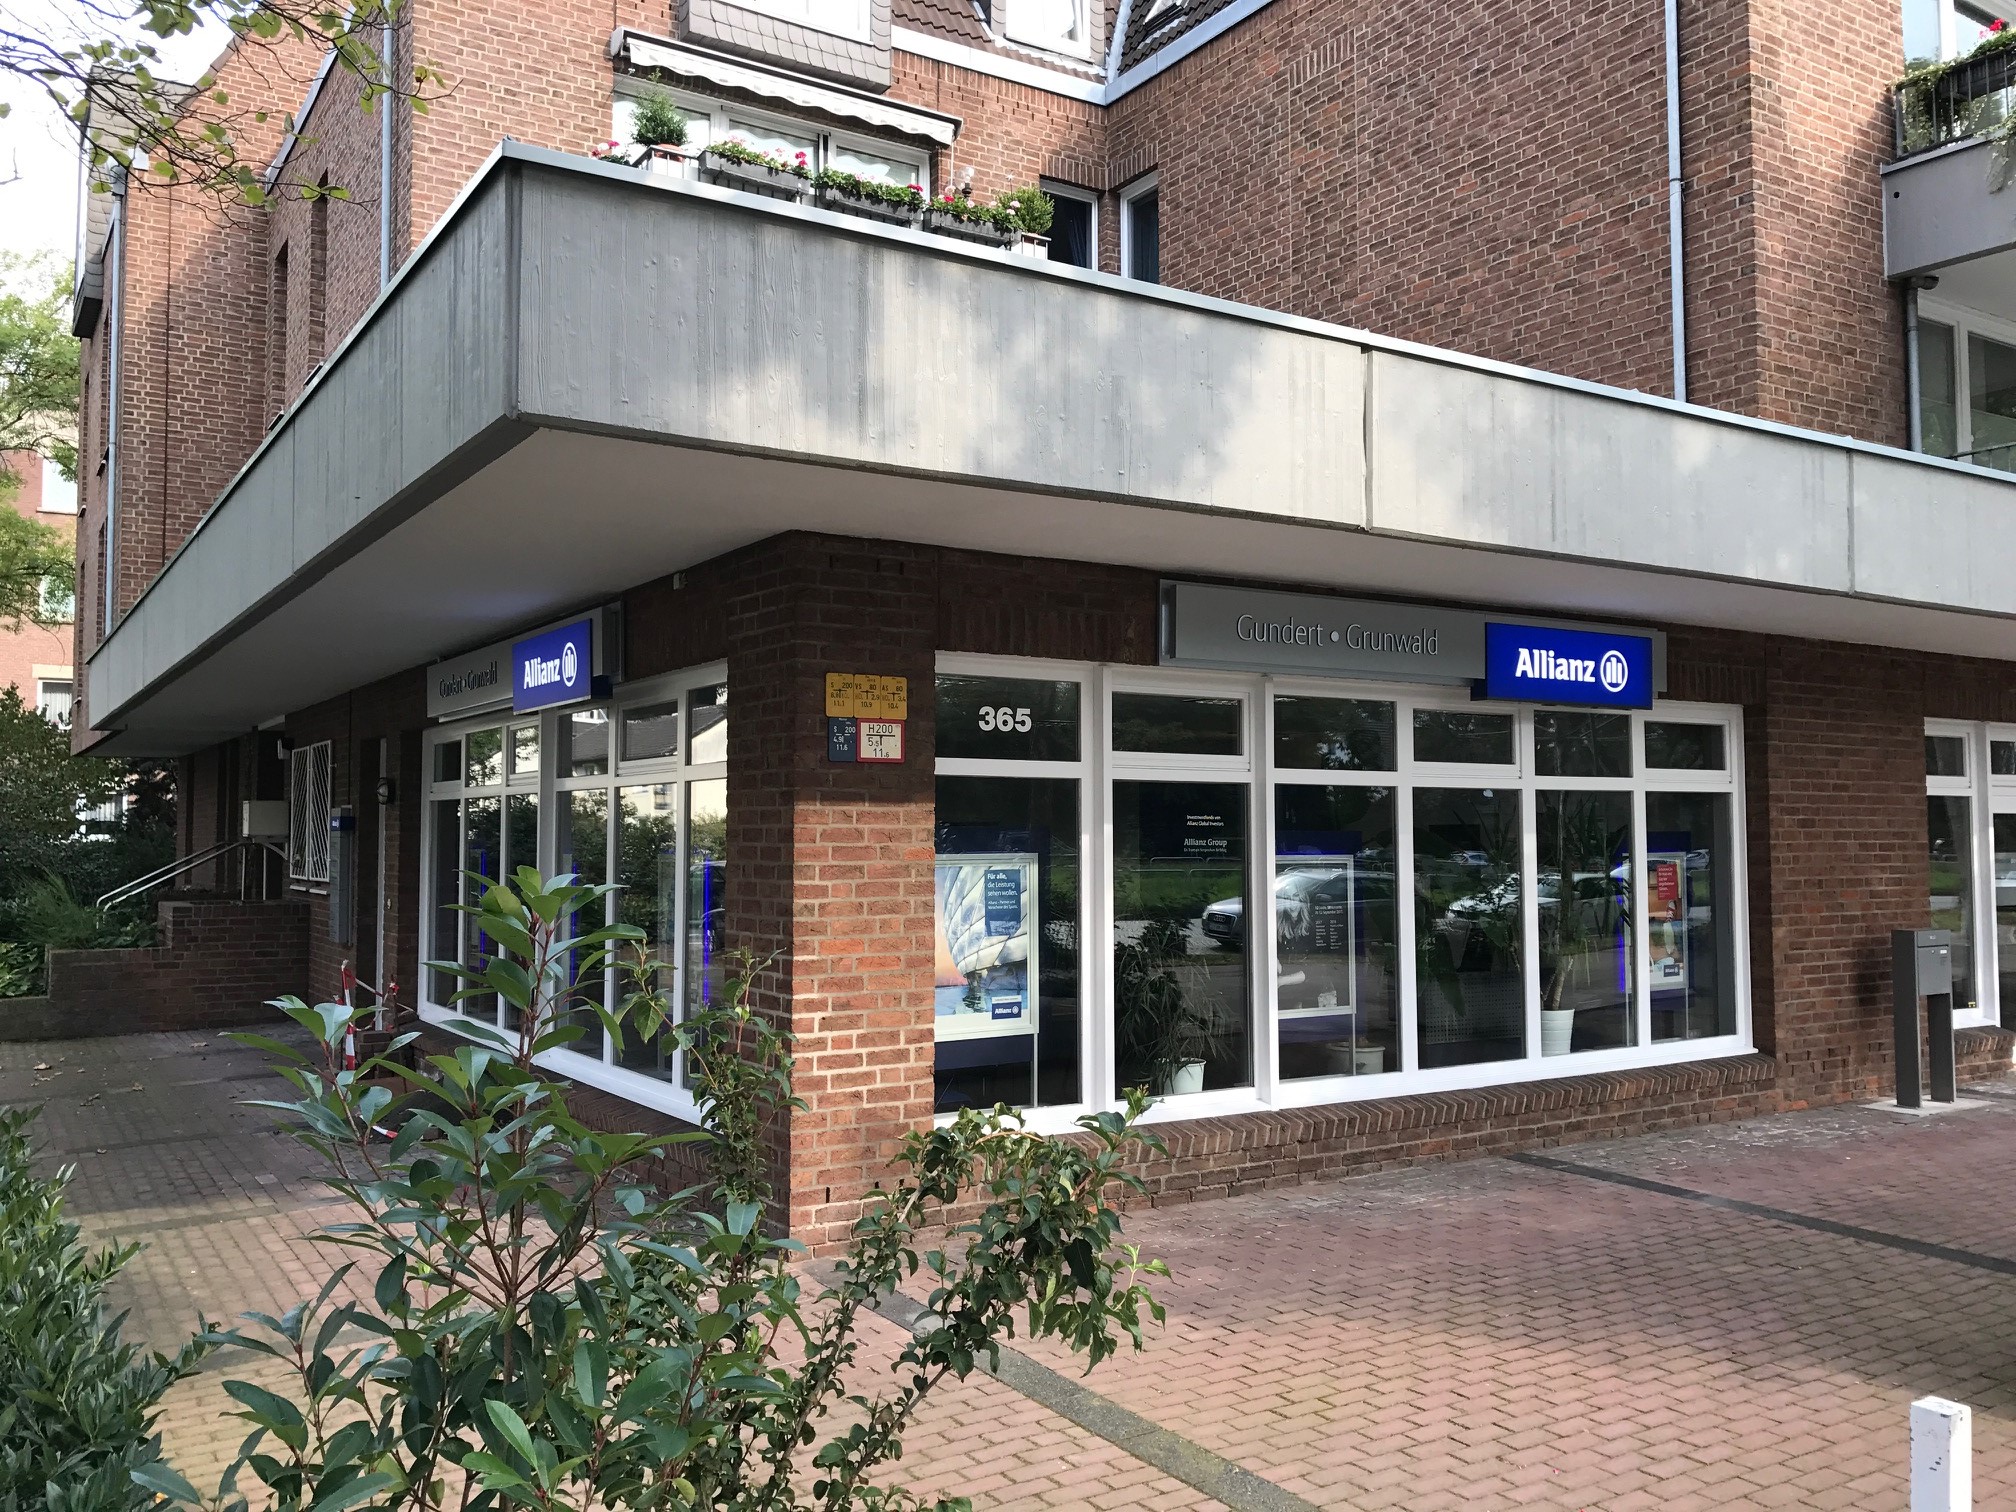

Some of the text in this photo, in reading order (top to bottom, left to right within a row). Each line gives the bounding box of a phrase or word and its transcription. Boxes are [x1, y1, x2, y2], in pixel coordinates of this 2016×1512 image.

[1236, 614, 1438, 656] Gundert Grunwald
[523, 656, 561, 689] Allianz
[1515, 647, 1596, 683] Allianz
[978, 706, 1032, 733] 365
[844, 726, 856, 734] 200
[873, 748, 890, 758] 11.6
[1184, 838, 1227, 847] Allianz Group
[995, 881, 1015, 889] Leistung
